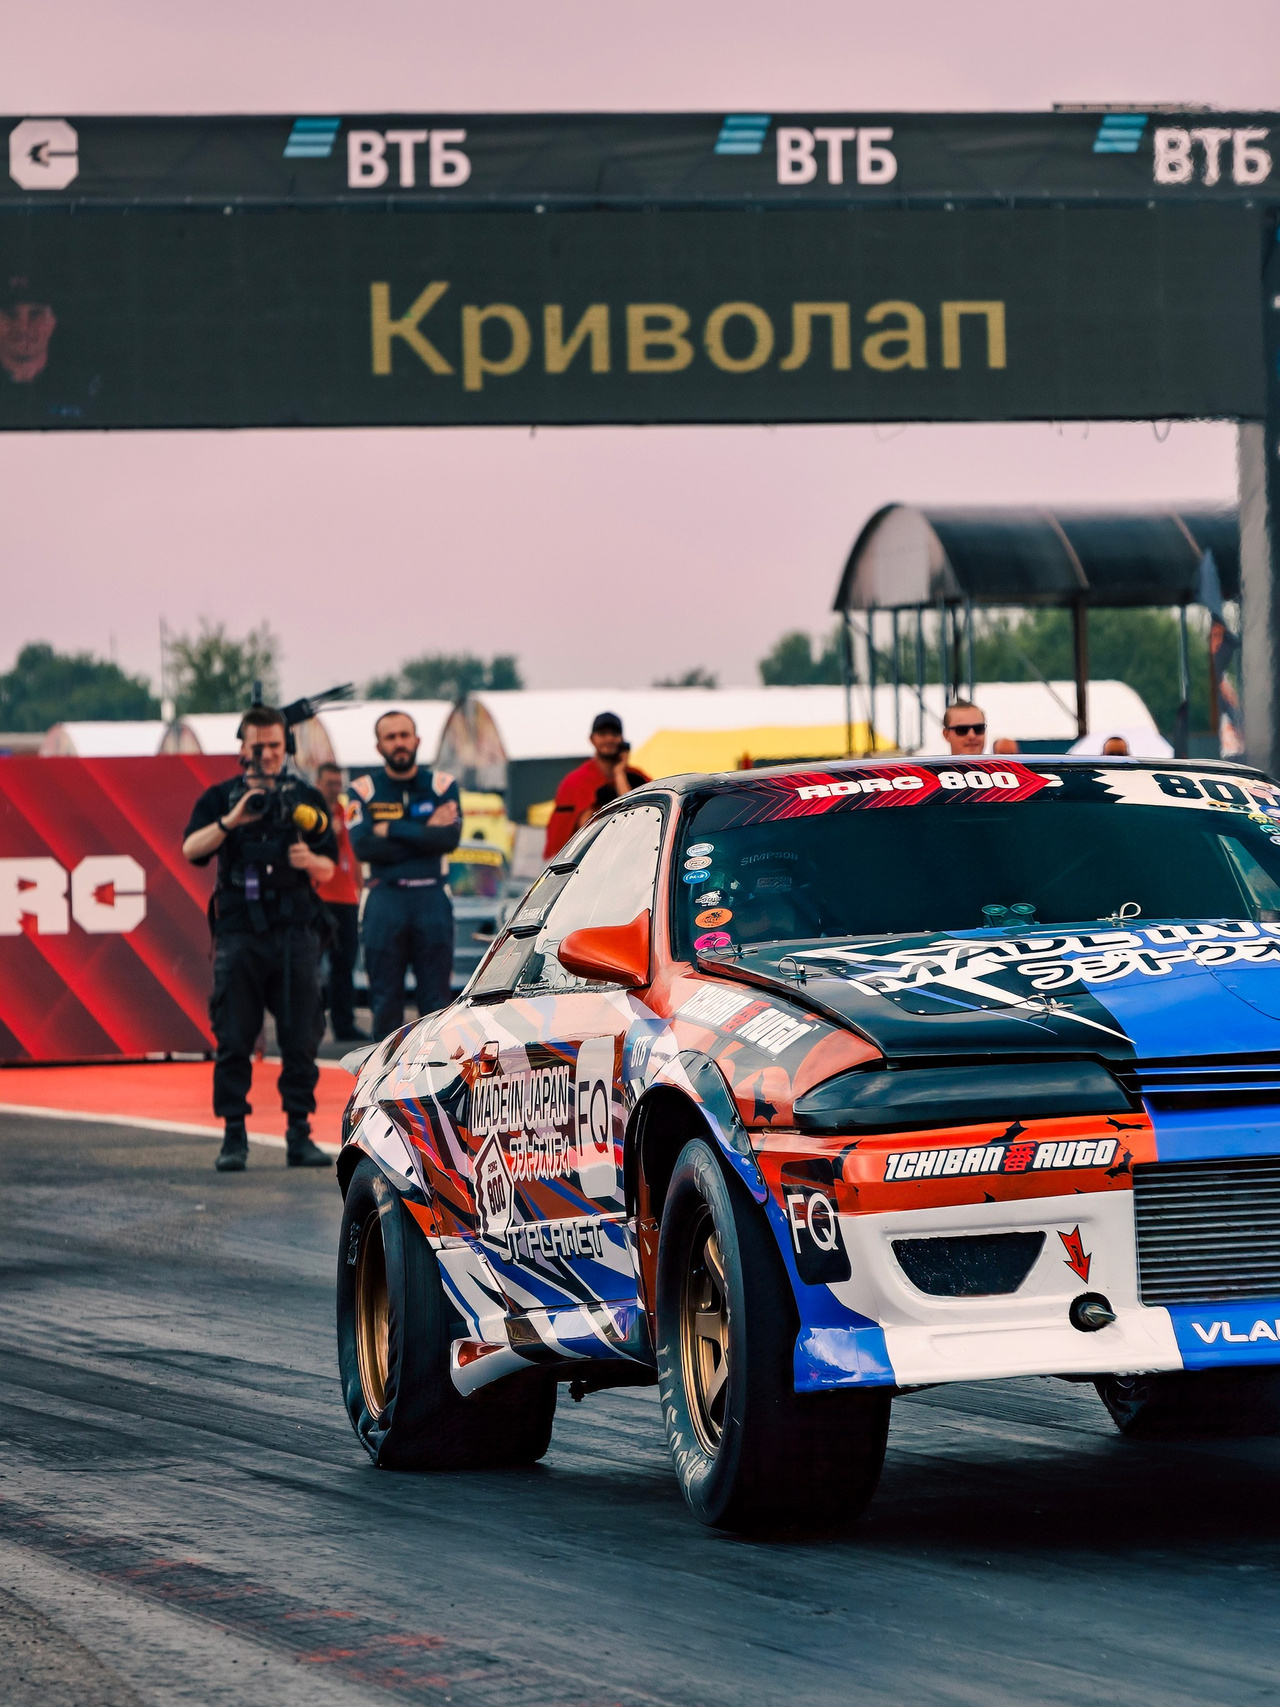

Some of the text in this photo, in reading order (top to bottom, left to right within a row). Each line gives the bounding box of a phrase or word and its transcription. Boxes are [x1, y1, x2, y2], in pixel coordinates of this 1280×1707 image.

[347, 129, 471, 188] ВТБ
[775, 127, 898, 185] ВТБ
[1153, 127, 1273, 186] ВТБ
[369, 281, 1006, 392] Криволап
[795, 771, 1021, 800] RDRC 800
[472, 1065, 569, 1136] MADE IN JAPAN
[579, 1079, 609, 1156] FQ
[885, 1146, 1005, 1180] ICHIBAN
[1032, 1139, 1118, 1169] AUTO
[487, 1174, 507, 1216] 800
[787, 1192, 839, 1254] FQ
